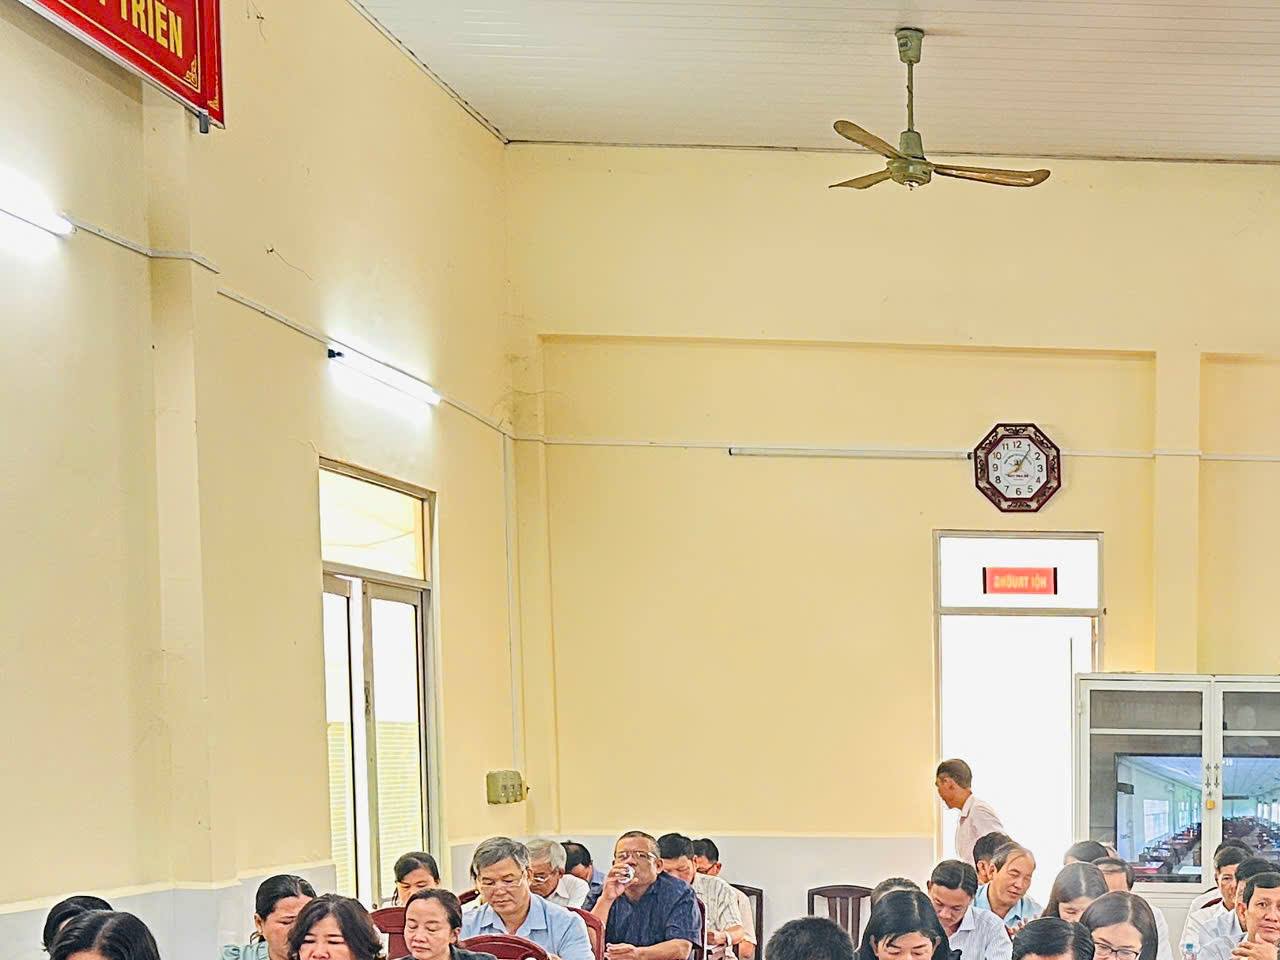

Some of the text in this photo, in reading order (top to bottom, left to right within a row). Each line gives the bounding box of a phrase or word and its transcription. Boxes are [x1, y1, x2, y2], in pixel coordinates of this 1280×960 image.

[993, 452, 1001, 460] 10
[1035, 452, 1041, 460] 2
[1015, 488, 1022, 496] 6
[1027, 485, 1033, 493] 5
